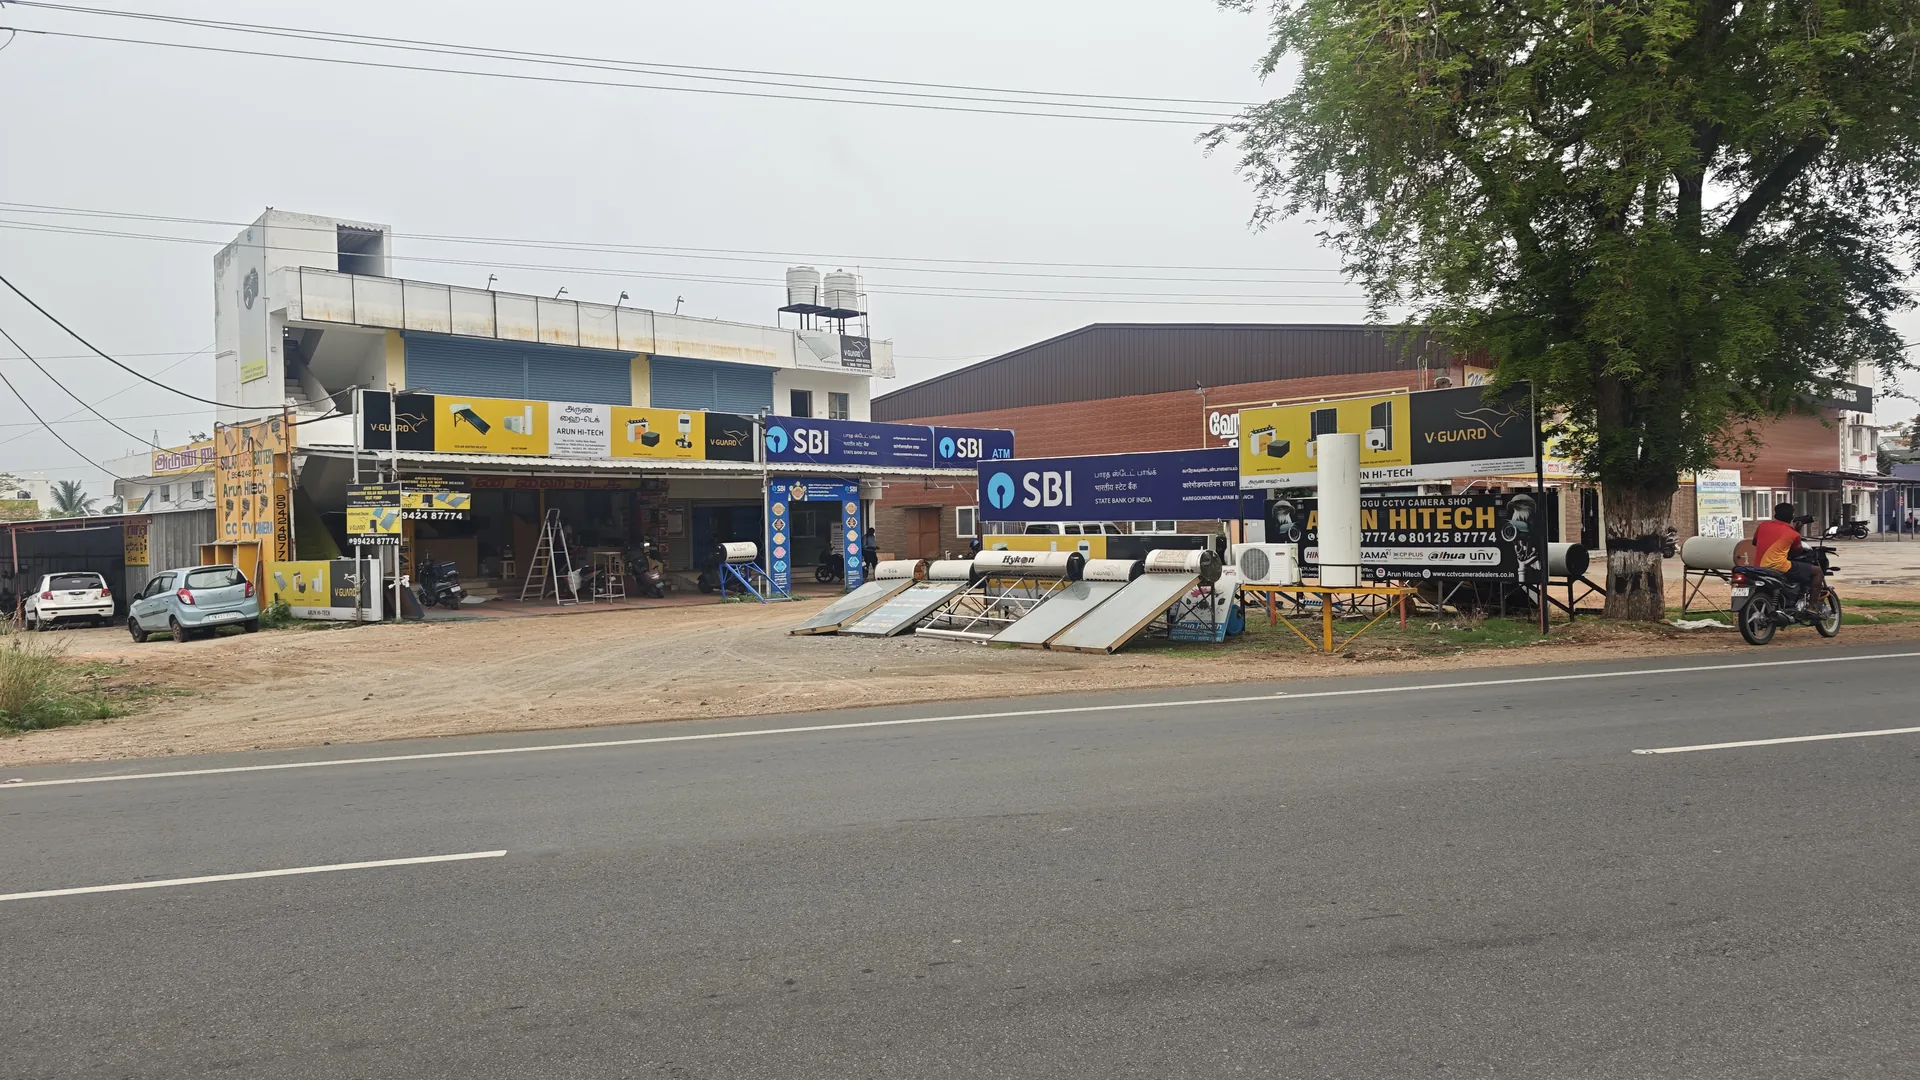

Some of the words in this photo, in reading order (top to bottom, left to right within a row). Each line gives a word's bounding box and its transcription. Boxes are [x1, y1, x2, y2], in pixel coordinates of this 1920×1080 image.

[793, 429, 829, 454] SBI
[957, 438, 982, 458] SBI
[992, 448, 1011, 458] ATM
[1372, 468, 1413, 479] HI-TECH
[223, 482, 242, 497] Arun
[244, 479, 267, 495] Hitech
[1023, 470, 1072, 508] SBI
[1095, 482, 1113, 491] भारतीय
[1115, 482, 1127, 490] स्टेट
[1128, 481, 1137, 490] बैंक
[1382, 499, 1405, 507] CCTV
[1408, 498, 1445, 506] CAMERA
[1448, 498, 1473, 506] SHOP
[402, 512, 428, 520] 9424
[431, 512, 463, 520] 87774
[1306, 508, 1378, 530] AN
[1389, 506, 1495, 530] HITECH
[226, 522, 237, 535] CC
[242, 522, 253, 534] TV
[353, 537, 375, 545] 99424
[376, 537, 399, 545] 87774
[1409, 532, 1450, 543] 80125
[1454, 532, 1496, 543] 87774
[1002, 555, 1035, 565] Hykon
[1402, 570, 1421, 578] Hitech
